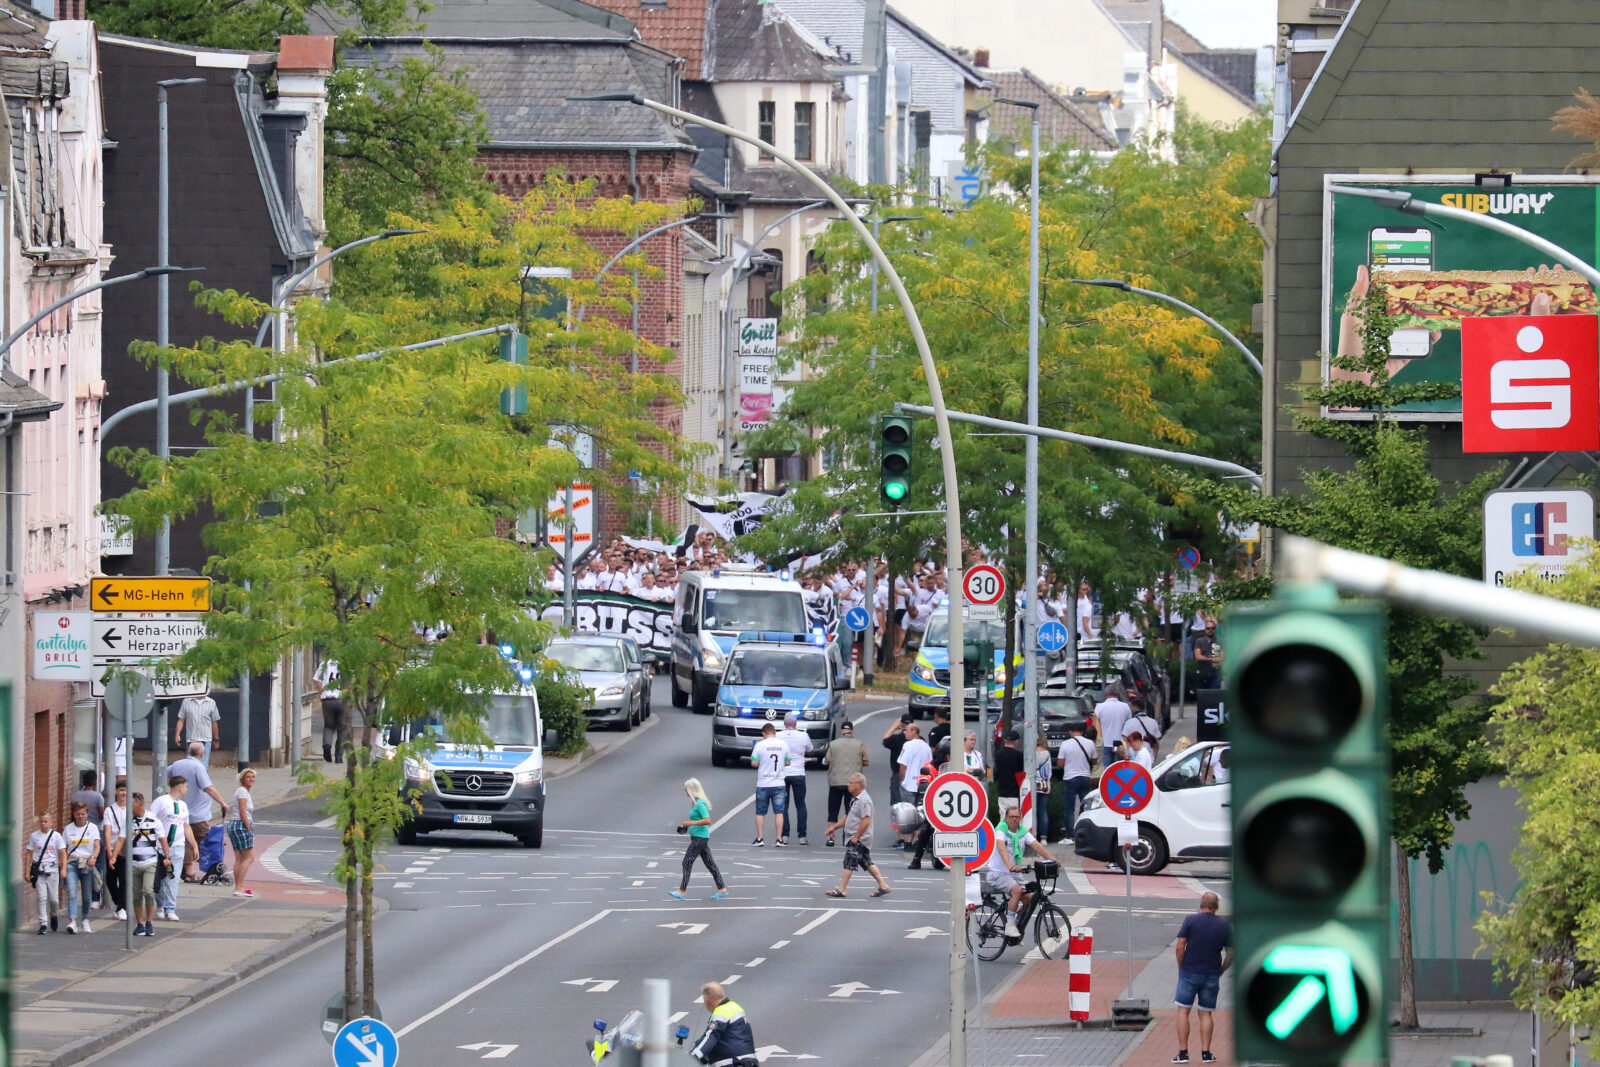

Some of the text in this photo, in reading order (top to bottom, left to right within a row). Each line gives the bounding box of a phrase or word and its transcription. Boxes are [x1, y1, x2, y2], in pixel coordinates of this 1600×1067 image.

[1441, 192, 1554, 214] SUBWAY
[741, 321, 775, 344] Grill
[743, 364, 768, 373] FREE
[744, 376, 768, 385] TIME
[741, 421, 769, 431] Gyros
[971, 576, 996, 595] 30
[124, 589, 184, 601] MG-Hehn
[128, 624, 204, 636] Reha-Klinik
[36, 633, 87, 654] antalya
[128, 640, 188, 653] Herzpark
[45, 653, 79, 662] GRILL
[748, 697, 797, 706] POLIZEI
[446, 753, 503, 761] POLIZEI
[938, 790, 973, 818] 30
[937, 841, 974, 849] Lärmschutz
